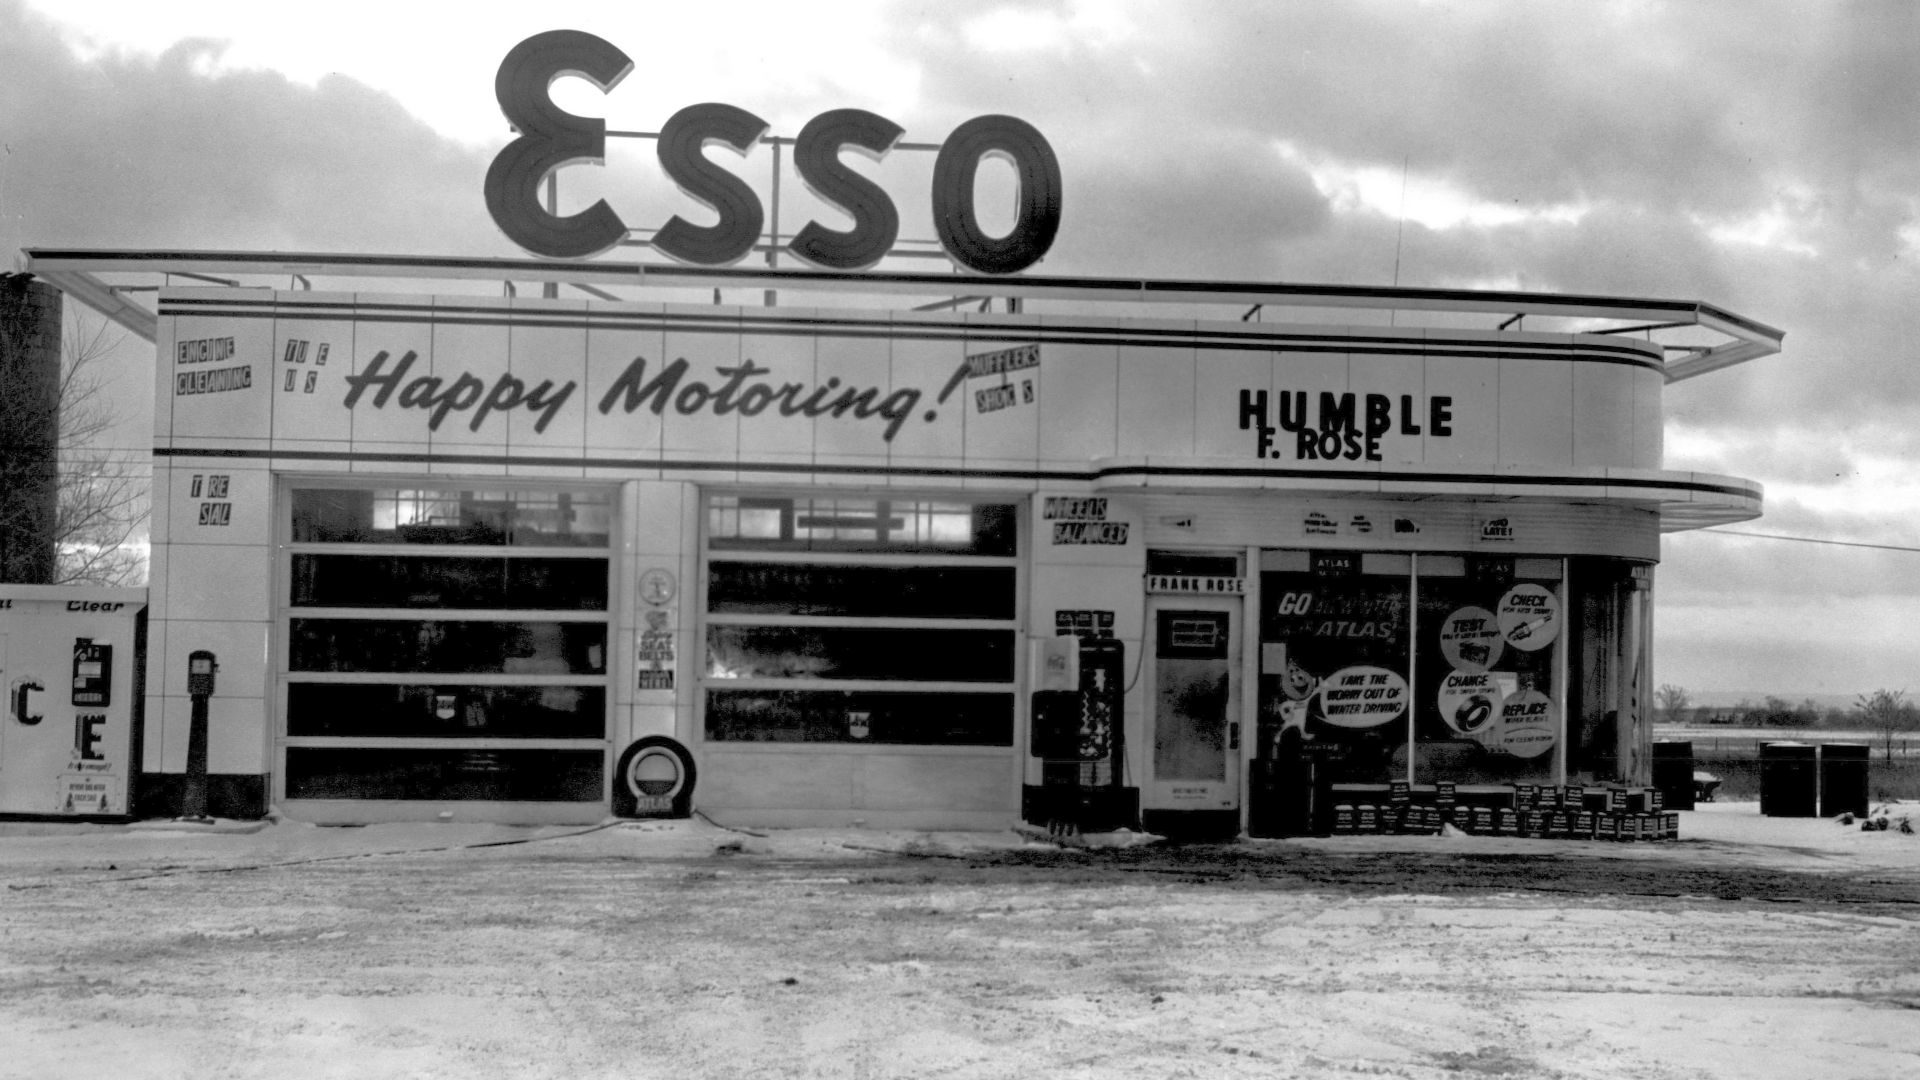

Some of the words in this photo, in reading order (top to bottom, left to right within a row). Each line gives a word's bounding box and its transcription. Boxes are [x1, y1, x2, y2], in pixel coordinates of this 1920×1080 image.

[178, 337, 234, 364] ENGINE
[967, 344, 1040, 379] MUFFLERS
[176, 365, 251, 396] CLEANING
[343, 350, 577, 434] Happy
[598, 356, 971, 442] Motoring!
[1240, 389, 1452, 437] HUMBLE
[1257, 427, 1280, 459] F.
[1297, 428, 1382, 462] ROSE
[199, 503, 232, 526] SAL
[1044, 497, 1107, 520] WHEELS
[1053, 522, 1130, 545] BALANCED
[1150, 578, 1200, 592] FRANK
[1207, 579, 1244, 592] ROSE
[1278, 592, 1313, 616] GO
[1510, 594, 1548, 607] CHECK
[1314, 621, 1393, 638] ATLAS
[1452, 618, 1488, 633] TEST
[639, 650, 673, 661] BELTS
[1341, 674, 1365, 686] TAKE
[1370, 674, 1390, 685] THE
[1447, 675, 1489, 688] CHANGE
[1327, 689, 1363, 701] WORRY
[1363, 688, 1386, 699] OUT
[1387, 687, 1402, 698] OF
[1327, 703, 1361, 715] WINTER
[1363, 702, 1402, 714] DRIVING
[1502, 702, 1548, 717] REPLACE
